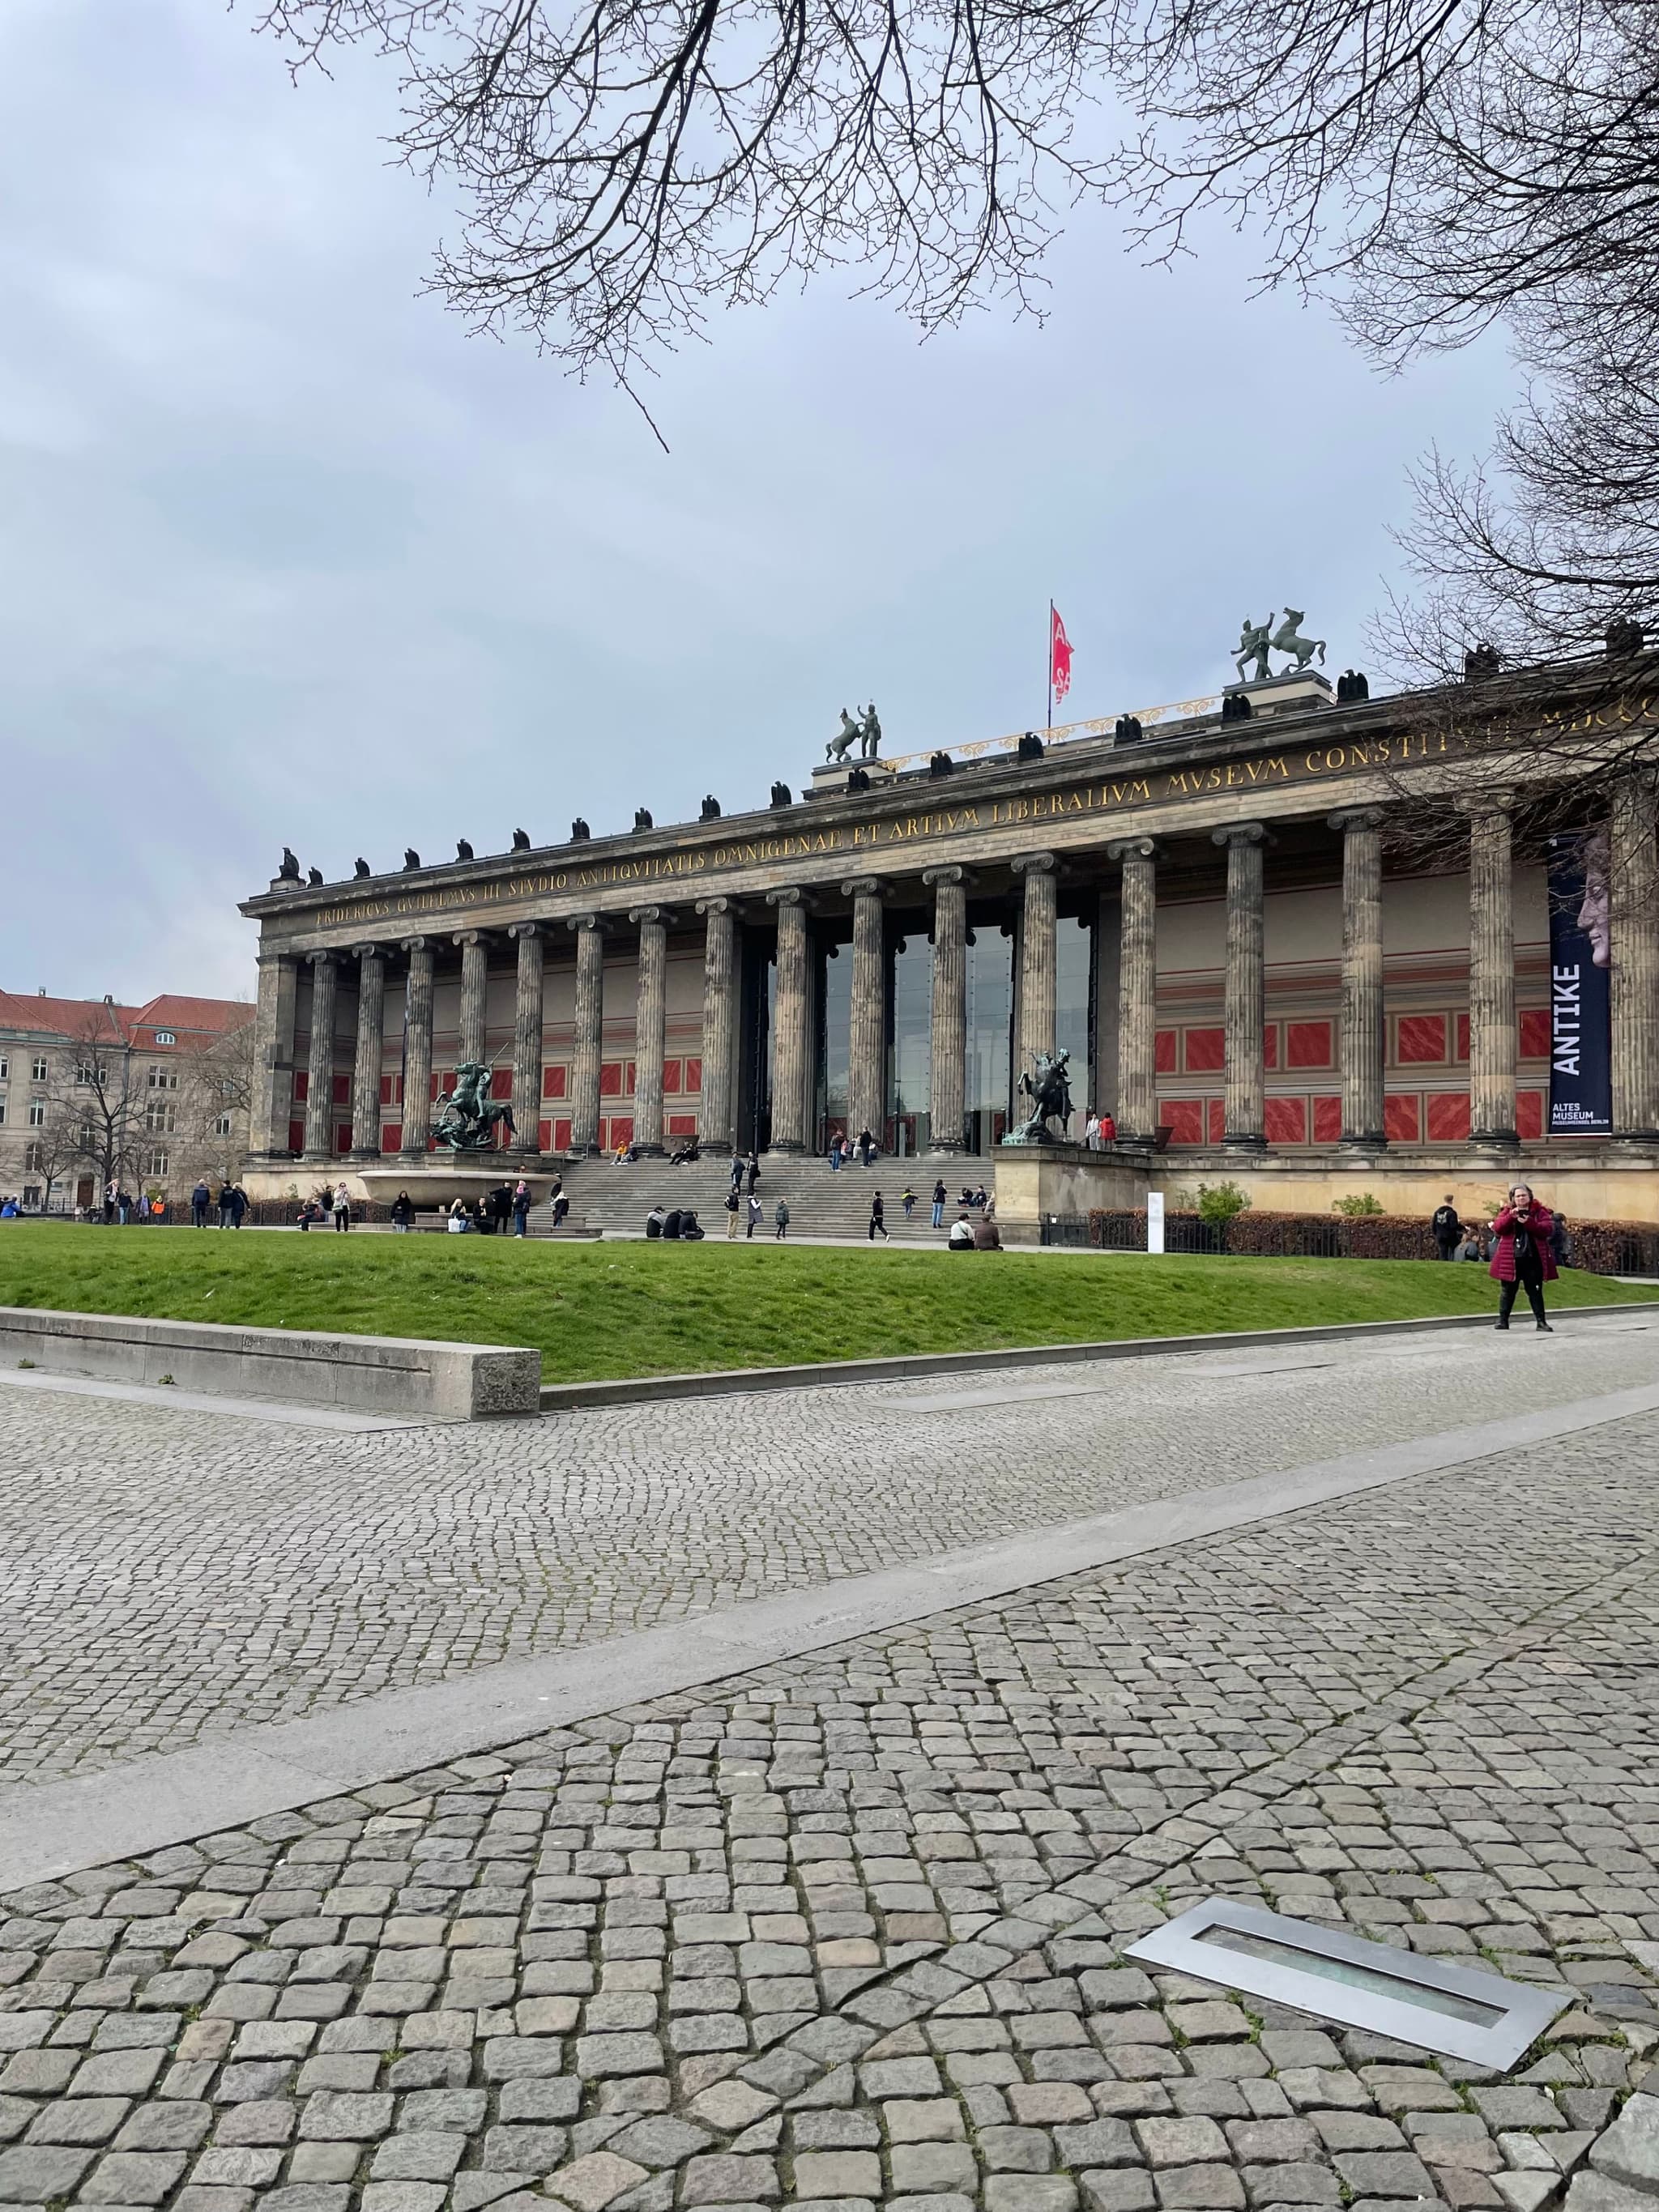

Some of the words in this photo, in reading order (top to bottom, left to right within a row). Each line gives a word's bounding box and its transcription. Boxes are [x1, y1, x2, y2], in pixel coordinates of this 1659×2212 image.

[317, 900, 389, 926] FRIDERICVS
[397, 888, 475, 913] GVILELMVS
[484, 884, 499, 900] III
[509, 874, 567, 897] STVDIO
[577, 852, 706, 887] ANTIQVITATIS
[714, 830, 842, 866] OMNIGENAE
[854, 825, 881, 845] ET
[889, 808, 979, 839] ARTIVM
[992, 780, 1151, 824] LIBERALIVM
[1166, 757, 1290, 796] MVSEVM
[1553, 964, 1580, 1076] ANTIKE
[1553, 1102, 1580, 1112] ALTES
[1553, 1111, 1593, 1120] MUSEUM
